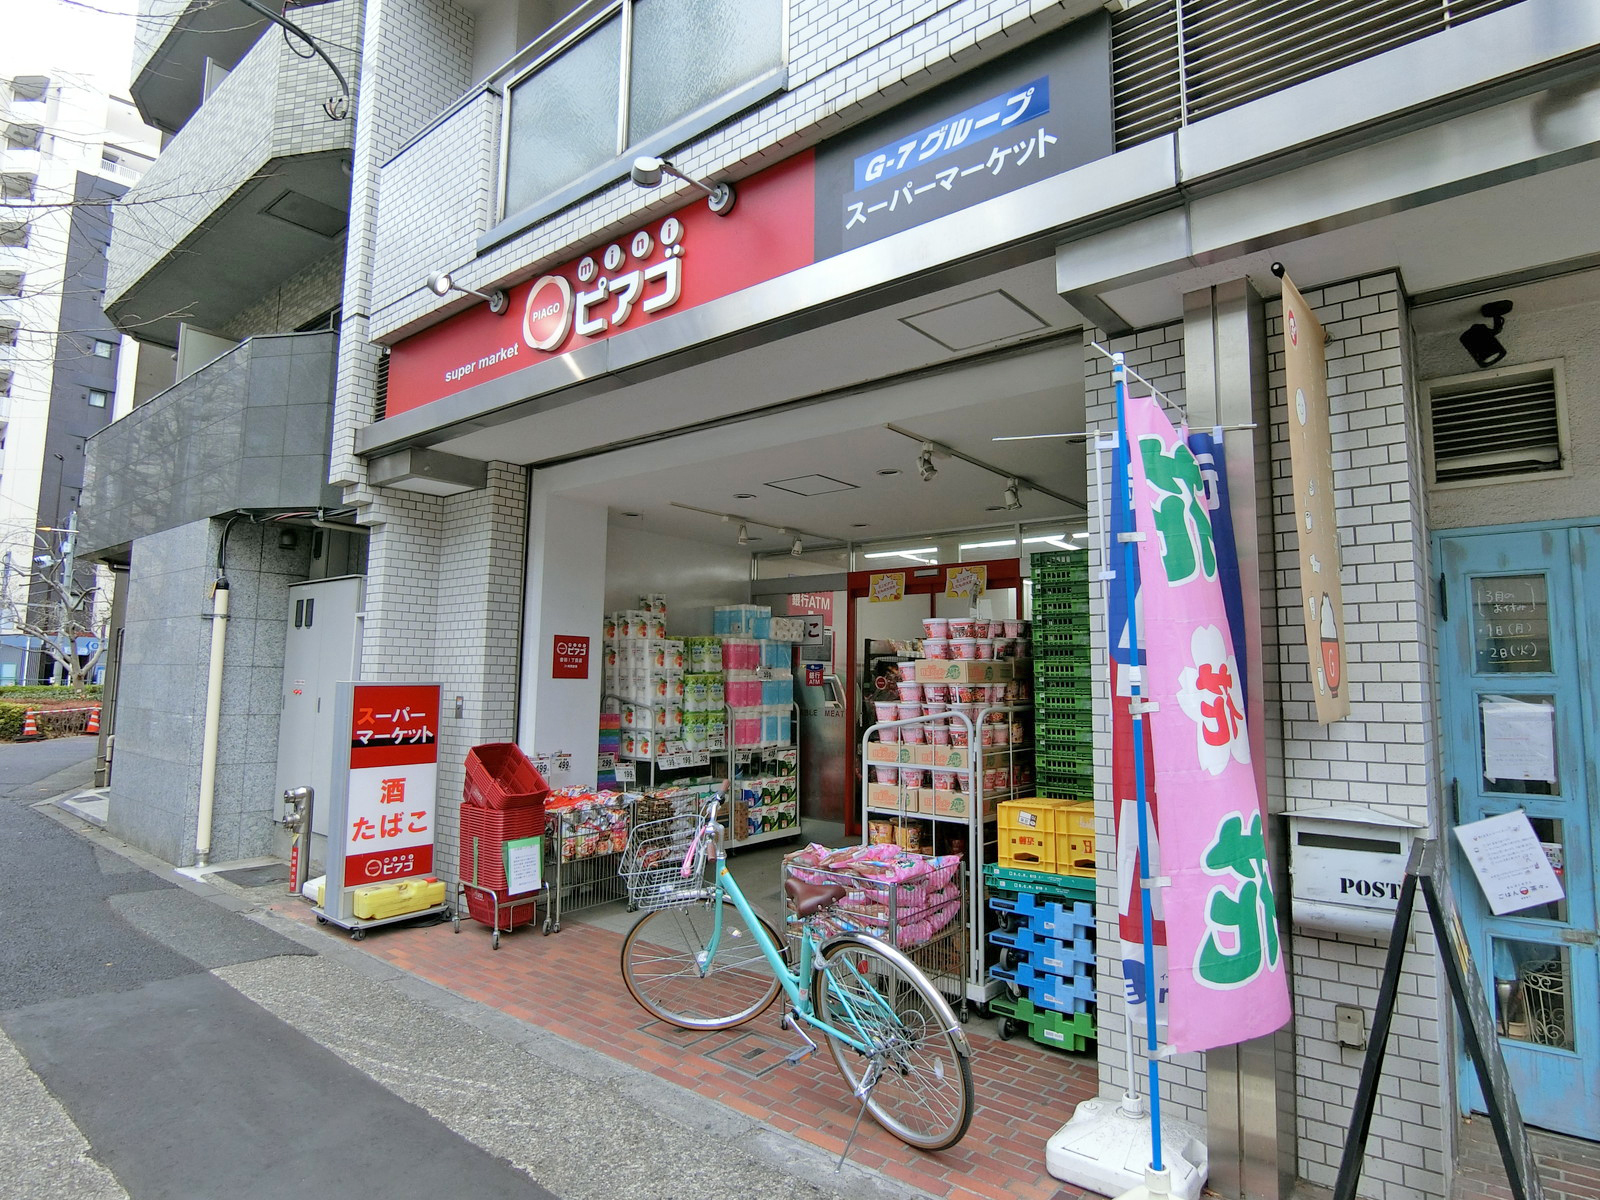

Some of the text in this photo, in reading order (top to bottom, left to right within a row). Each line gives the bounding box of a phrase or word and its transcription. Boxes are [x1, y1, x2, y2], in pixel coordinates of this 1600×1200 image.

[865, 87, 1035, 182] G-7グループ
[845, 127, 1058, 230] スーパーマーケット
[579, 222, 674, 275] mini
[575, 244, 684, 337] ピアゴ
[532, 302, 560, 322] PIAGO
[445, 342, 519, 382] super market
[791, 594, 831, 611] 銀行ATM
[1486, 590, 1515, 603] 3月の
[356, 706, 426, 726] スーパー
[824, 710, 845, 718] MEAT
[355, 725, 434, 745] マーケット
[558, 761, 570, 770] 499
[379, 777, 407, 804] 酒
[351, 810, 429, 842] たばこ
[383, 860, 415, 876] ピアゴ
[1339, 876, 1402, 900] POST
